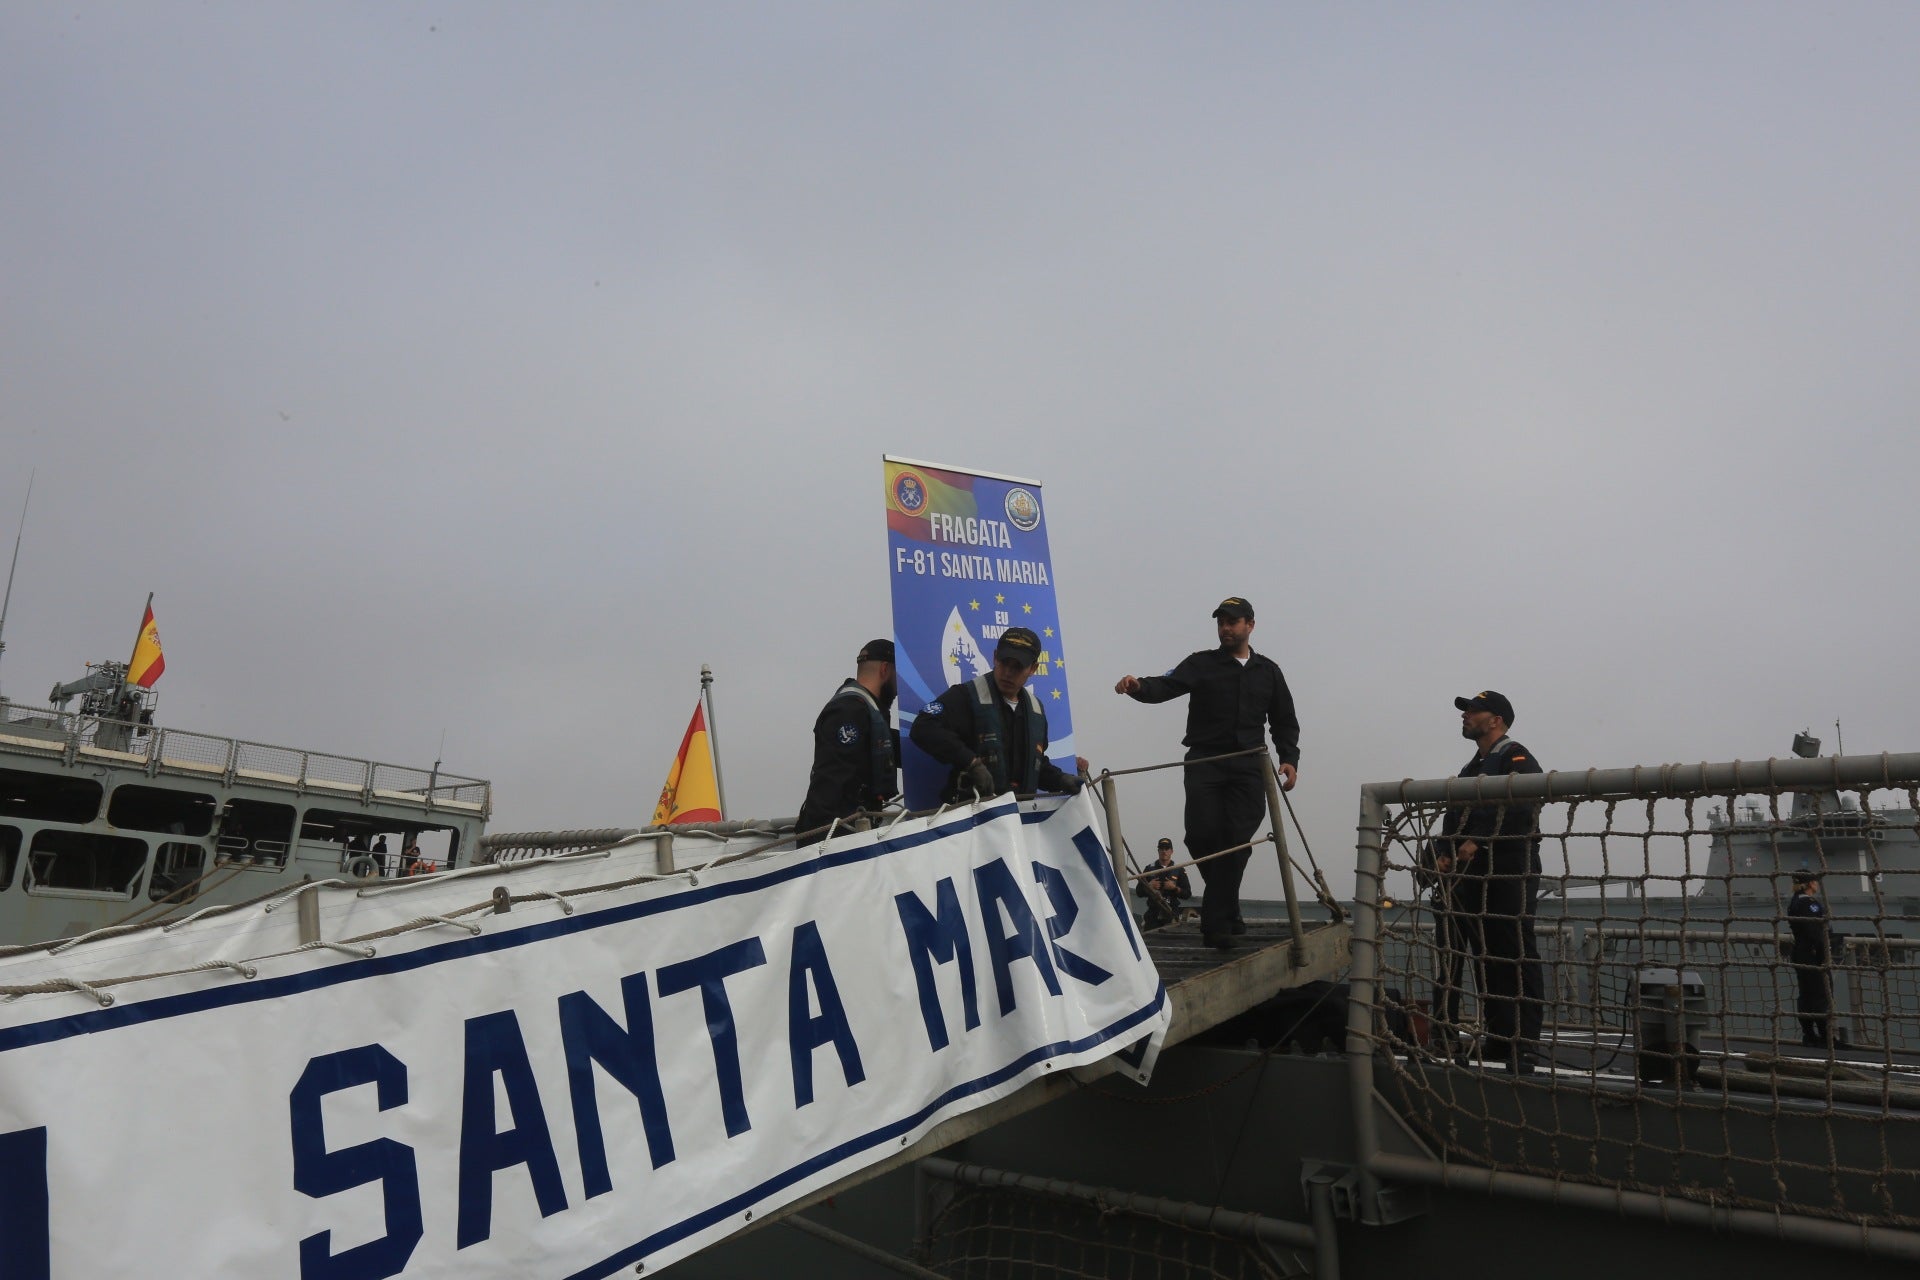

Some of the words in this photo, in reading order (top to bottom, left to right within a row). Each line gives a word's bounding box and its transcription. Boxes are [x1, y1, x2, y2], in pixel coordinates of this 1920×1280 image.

[930, 512, 1012, 549] FRAGATA
[896, 547, 936, 576] F-81
[941, 551, 994, 582] SANTA
[996, 558, 1049, 586] MARIA
[995, 610, 1009, 625] EU
[289, 920, 866, 1280] SANTA
